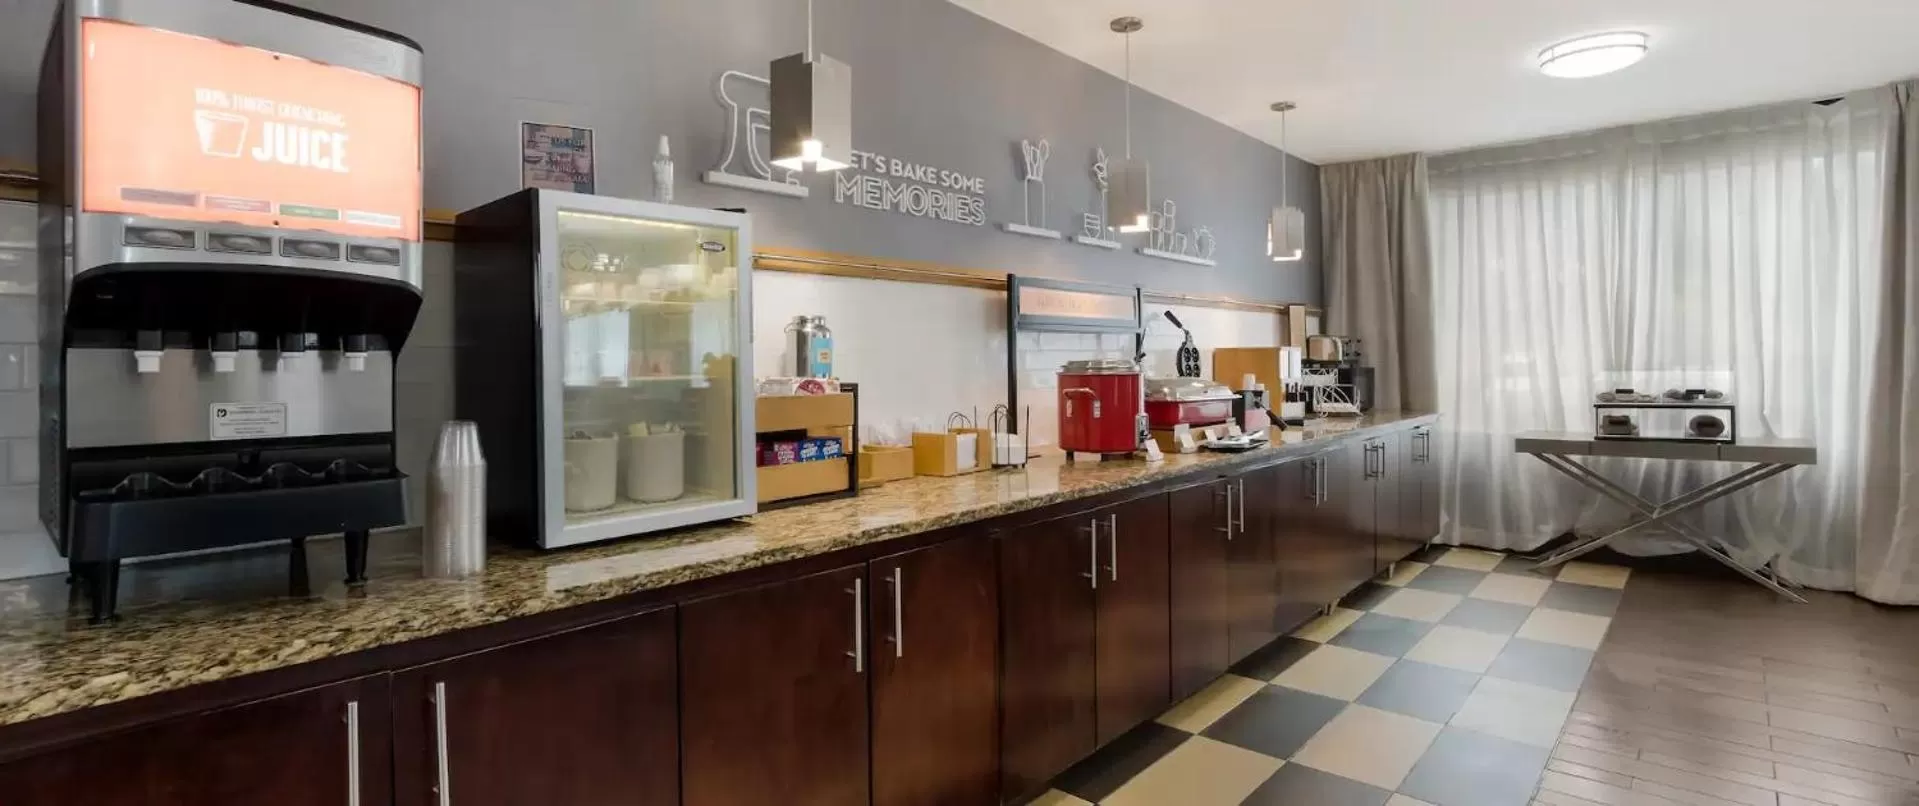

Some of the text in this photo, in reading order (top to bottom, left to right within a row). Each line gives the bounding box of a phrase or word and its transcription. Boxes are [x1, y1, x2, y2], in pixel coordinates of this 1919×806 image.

[251, 121, 350, 173] JUICE
[849, 150, 985, 194] ET'S BAKE SOME
[835, 170, 985, 226] MEMORIES
